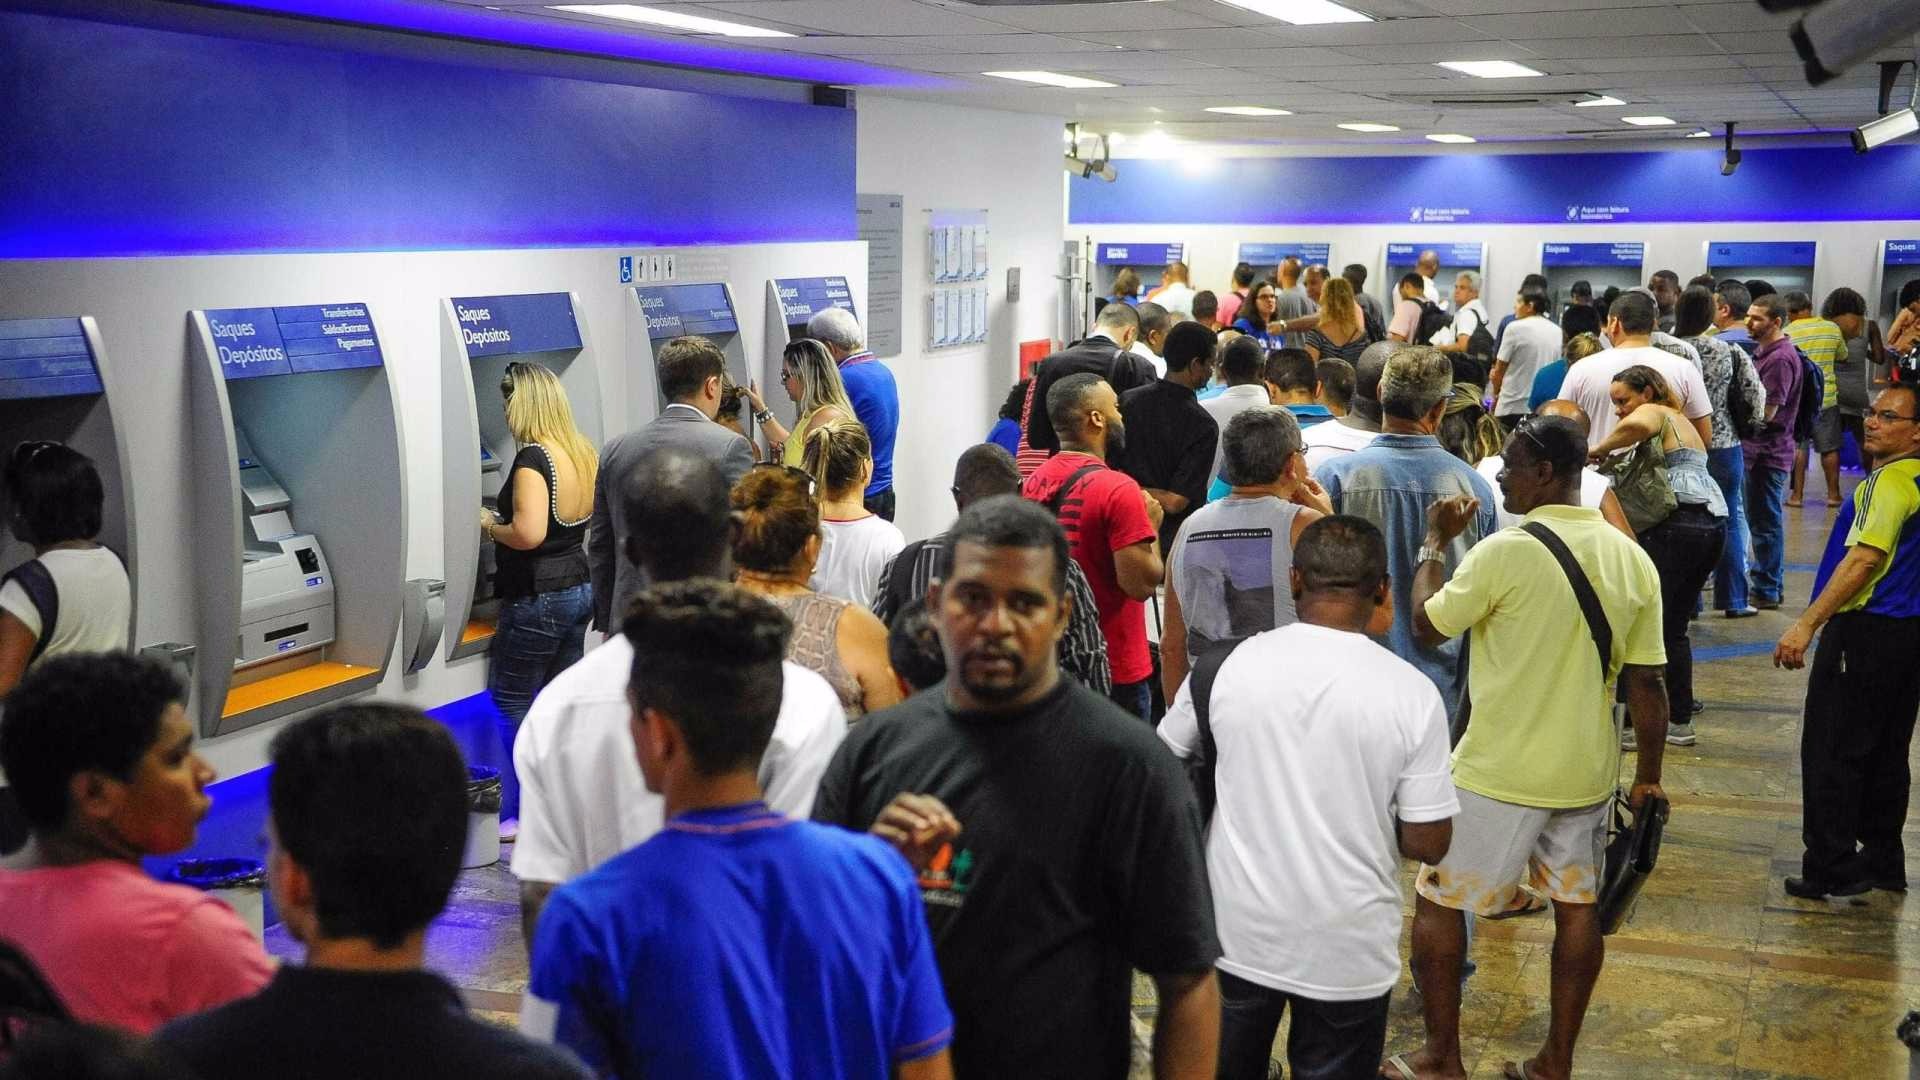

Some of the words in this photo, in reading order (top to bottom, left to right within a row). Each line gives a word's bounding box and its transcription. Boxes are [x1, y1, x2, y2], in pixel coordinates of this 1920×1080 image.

[1889, 243, 1916, 252] Saques
[778, 285, 798, 300] Saques
[640, 295, 664, 312] Saques
[783, 303, 811, 318] Depósitos
[457, 305, 491, 325] Saques
[644, 314, 681, 330] Depósitos
[211, 319, 256, 342] Saques
[463, 328, 511, 348] Depósitos
[219, 344, 284, 368] Depósitos
